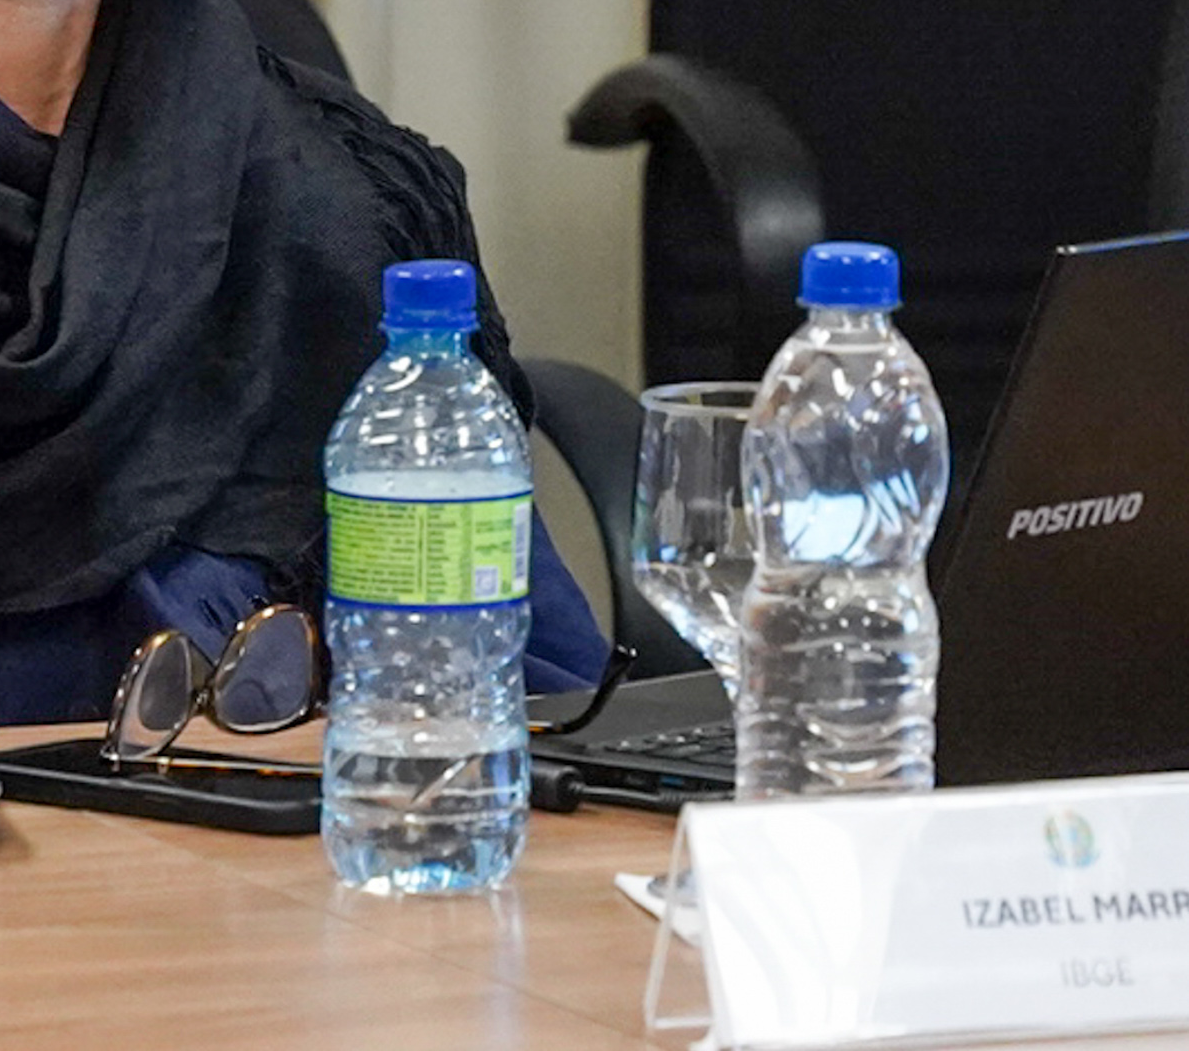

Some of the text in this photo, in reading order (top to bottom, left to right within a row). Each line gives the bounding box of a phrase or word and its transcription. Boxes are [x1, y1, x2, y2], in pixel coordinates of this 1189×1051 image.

[1007, 491, 1144, 540] POSITIVO
[962, 894, 1086, 928] IZABEL
[1060, 955, 1136, 988] IBGE
